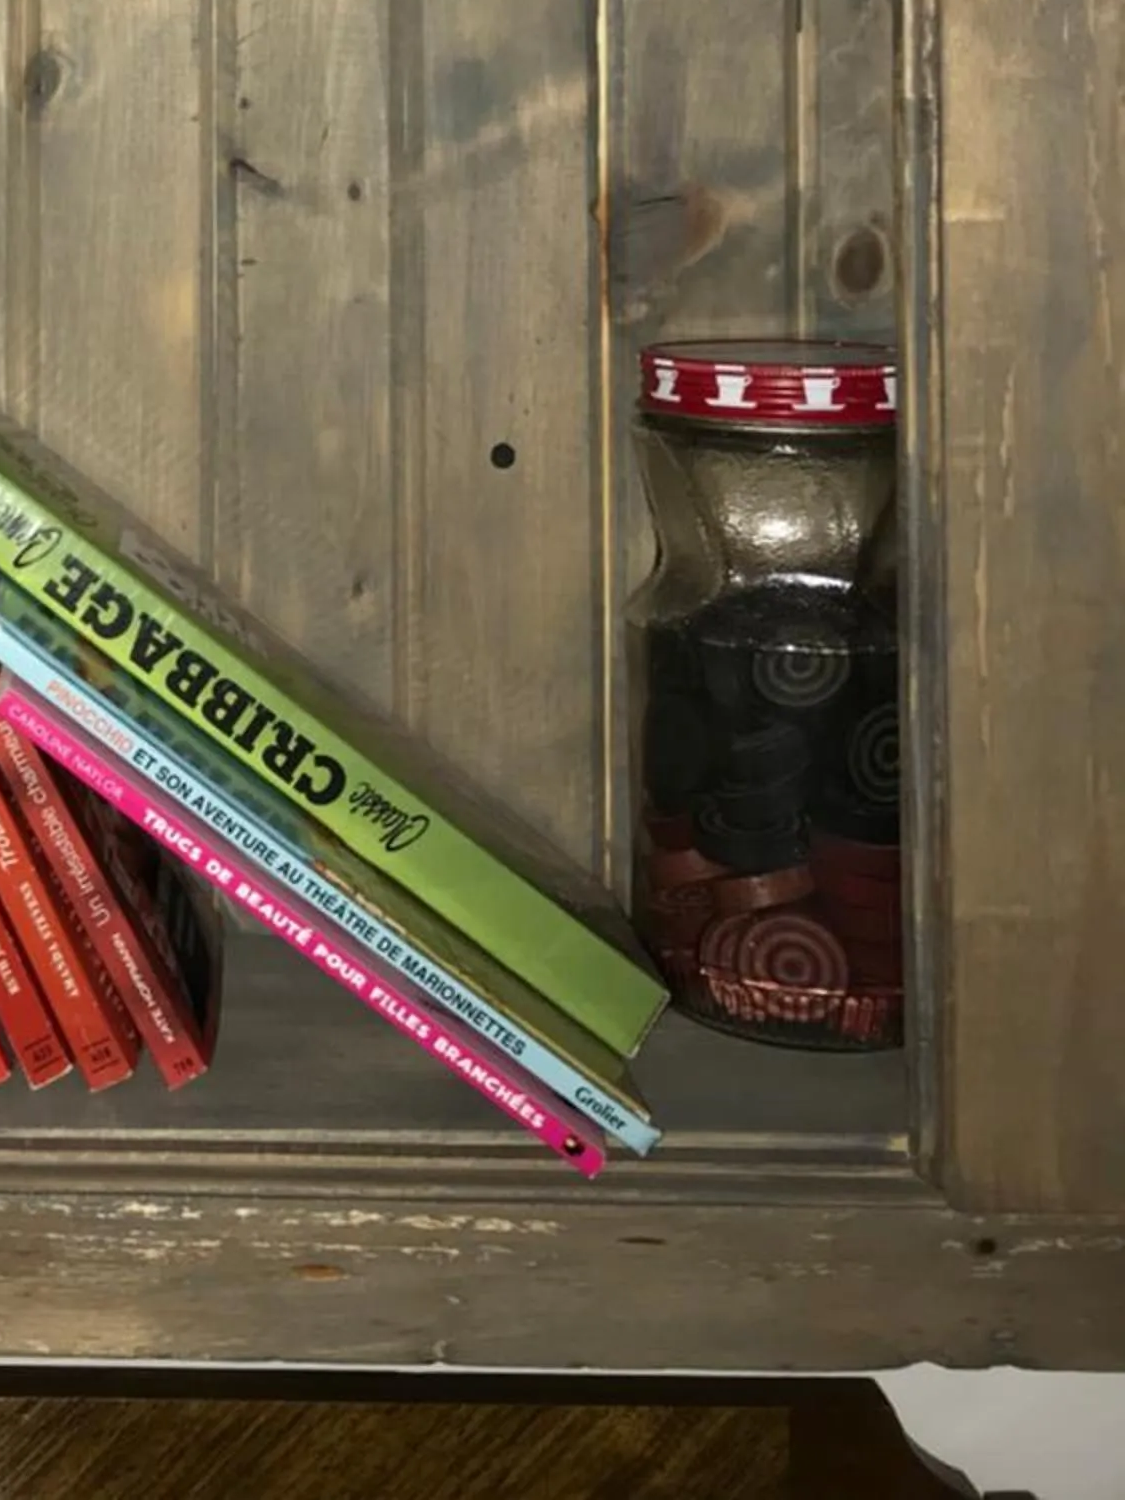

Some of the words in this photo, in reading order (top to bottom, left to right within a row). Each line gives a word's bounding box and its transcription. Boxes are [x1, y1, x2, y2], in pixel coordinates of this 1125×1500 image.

[39, 550, 356, 814] CRIBBAGE
[36, 805, 96, 897] irrésistible
[334, 770, 432, 862] Classic
[17, 880, 54, 941] STEVENS
[43, 677, 136, 756] PINOCCHIO
[130, 746, 157, 773] ET
[154, 764, 194, 801] SON
[189, 791, 279, 868] AVENTURE
[274, 858, 304, 886] AU
[302, 875, 381, 944] THÉÂTRE
[374, 934, 405, 963] DE
[398, 949, 528, 1059] MARIONNETTES
[570, 1081, 630, 1135] Grolier
[84, 894, 112, 928] Un
[45, 941, 80, 999] AMANDA
[110, 931, 158, 1008] HOFFMANN
[138, 806, 205, 863] TRUCS
[202, 856, 236, 887] DE
[233, 877, 313, 946] BEAUTÉ
[309, 939, 370, 991] POUR
[367, 984, 433, 1040] FILLES
[431, 1031, 550, 1130] BRANCHÉES
[150, 1007, 176, 1044] KATE
